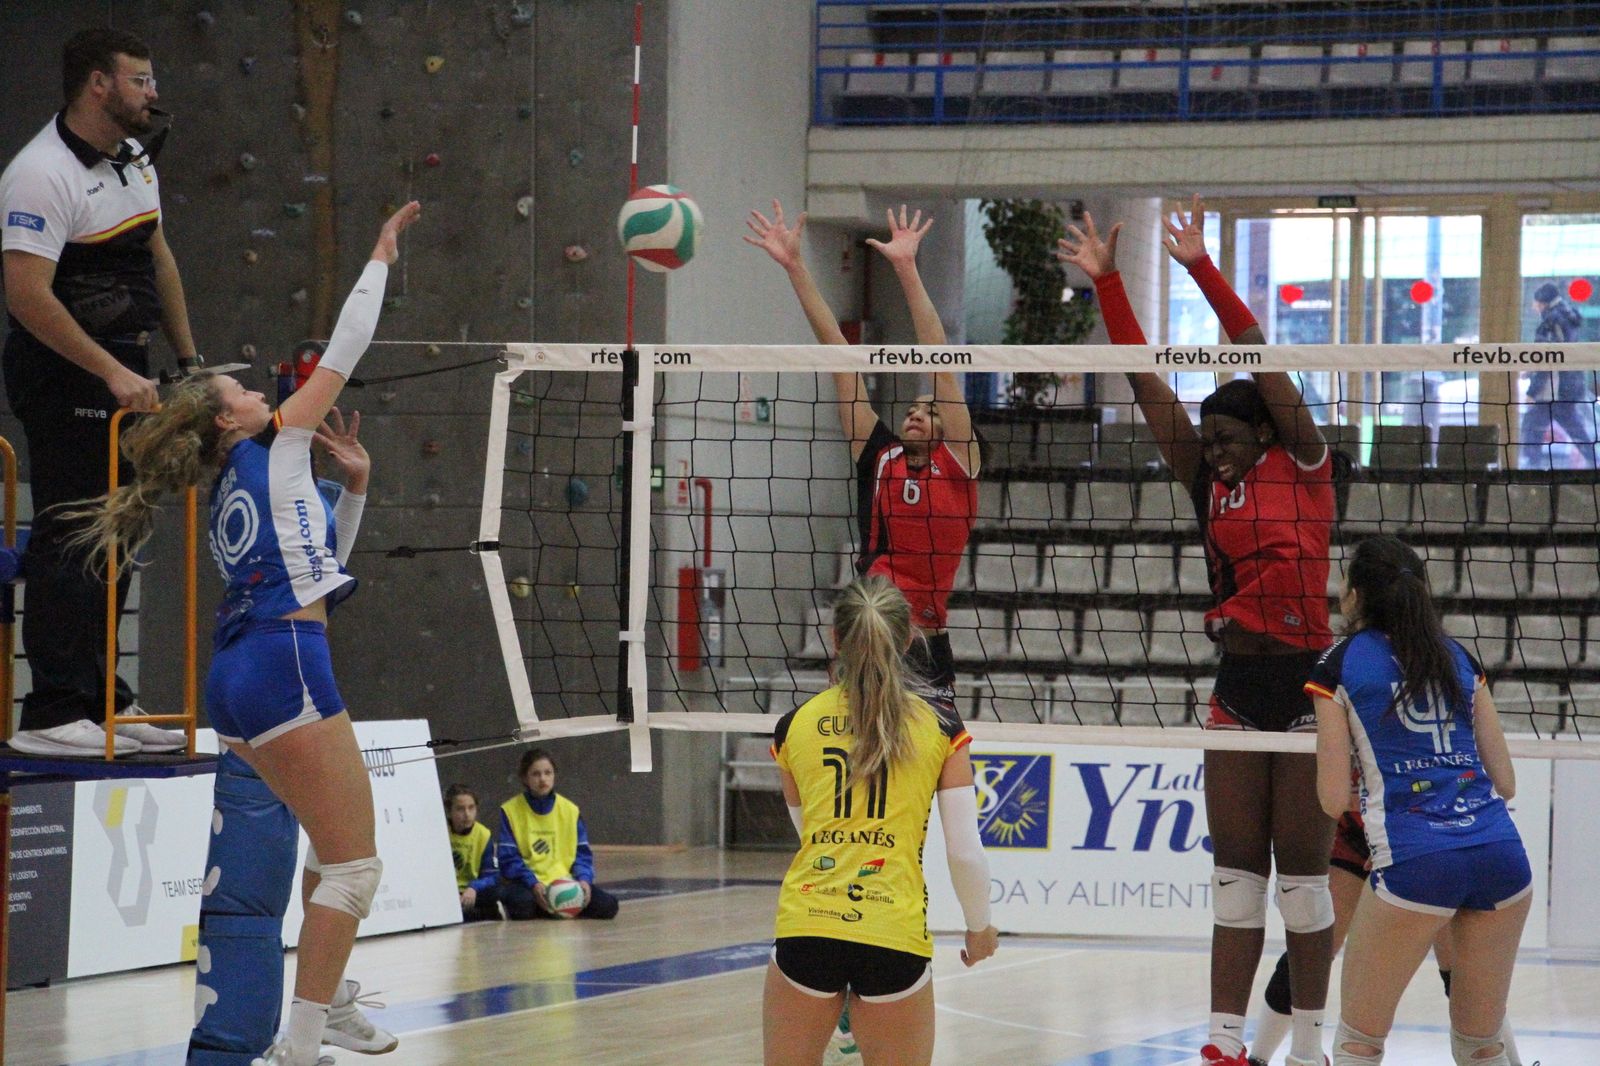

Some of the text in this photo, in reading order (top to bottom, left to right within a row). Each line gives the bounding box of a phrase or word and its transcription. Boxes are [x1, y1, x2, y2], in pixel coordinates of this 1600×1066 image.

[11, 214, 39, 228] TSK
[868, 349, 973, 367] rfevb.com
[1154, 348, 1263, 366] rfevb.com
[1452, 347, 1566, 365] rfevb.com
[74, 407, 107, 419] RFEVB
[902, 478, 922, 506] 6
[1390, 681, 1457, 754] 4
[1394, 750, 1475, 775] LEGANÉS
[162, 880, 186, 898] TEAM
[1037, 879, 1058, 905] Y
[1067, 881, 1212, 910] ALIMENT
[808, 906, 841, 918] Viviendas
